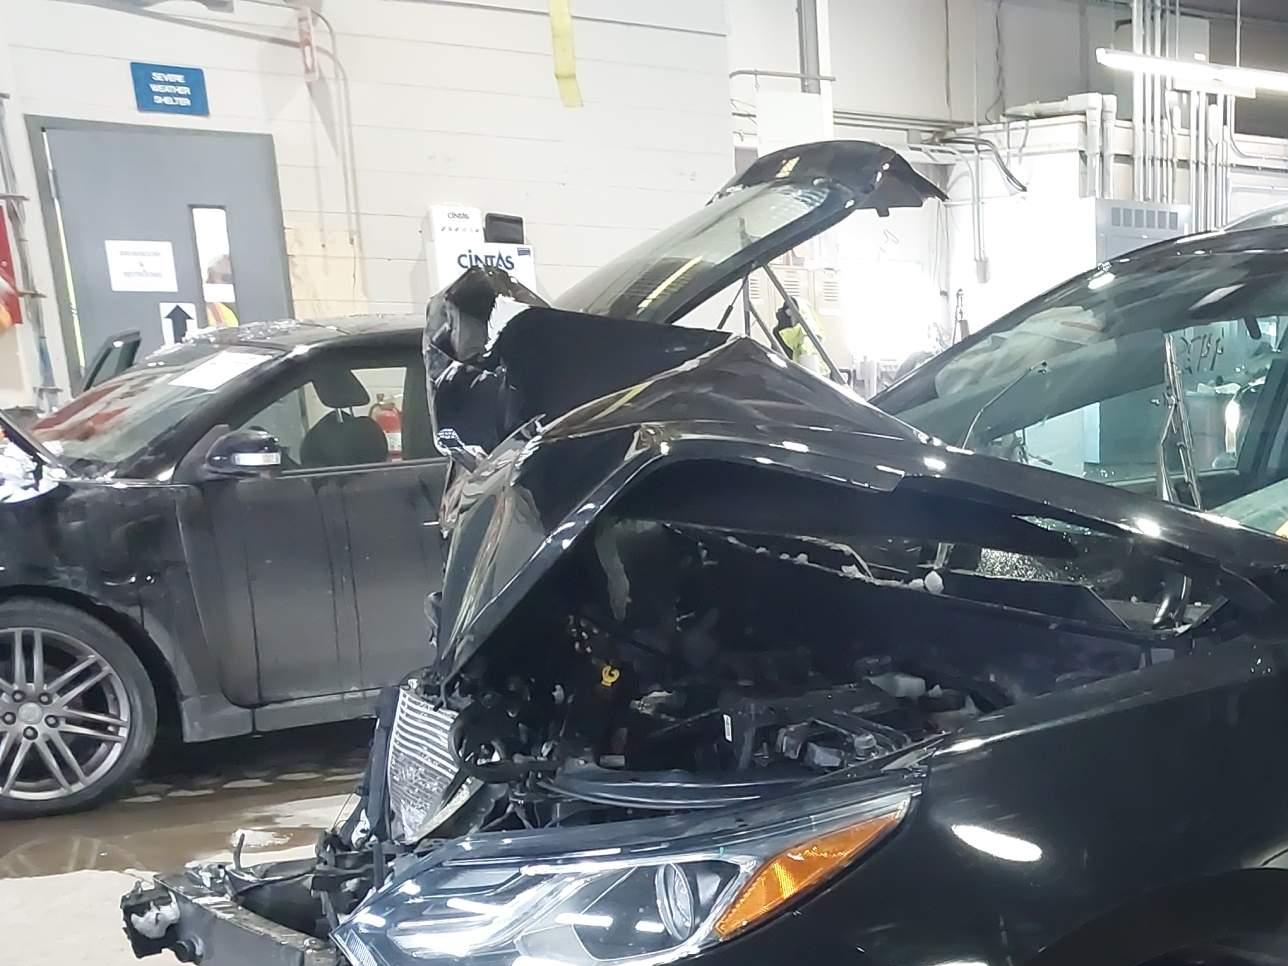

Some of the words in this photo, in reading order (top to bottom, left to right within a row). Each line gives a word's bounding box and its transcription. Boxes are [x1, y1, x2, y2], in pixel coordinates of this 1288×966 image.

[151, 72, 186, 83] SEVERE
[148, 84, 191, 95] WEATHER
[153, 95, 191, 106] SHELTER
